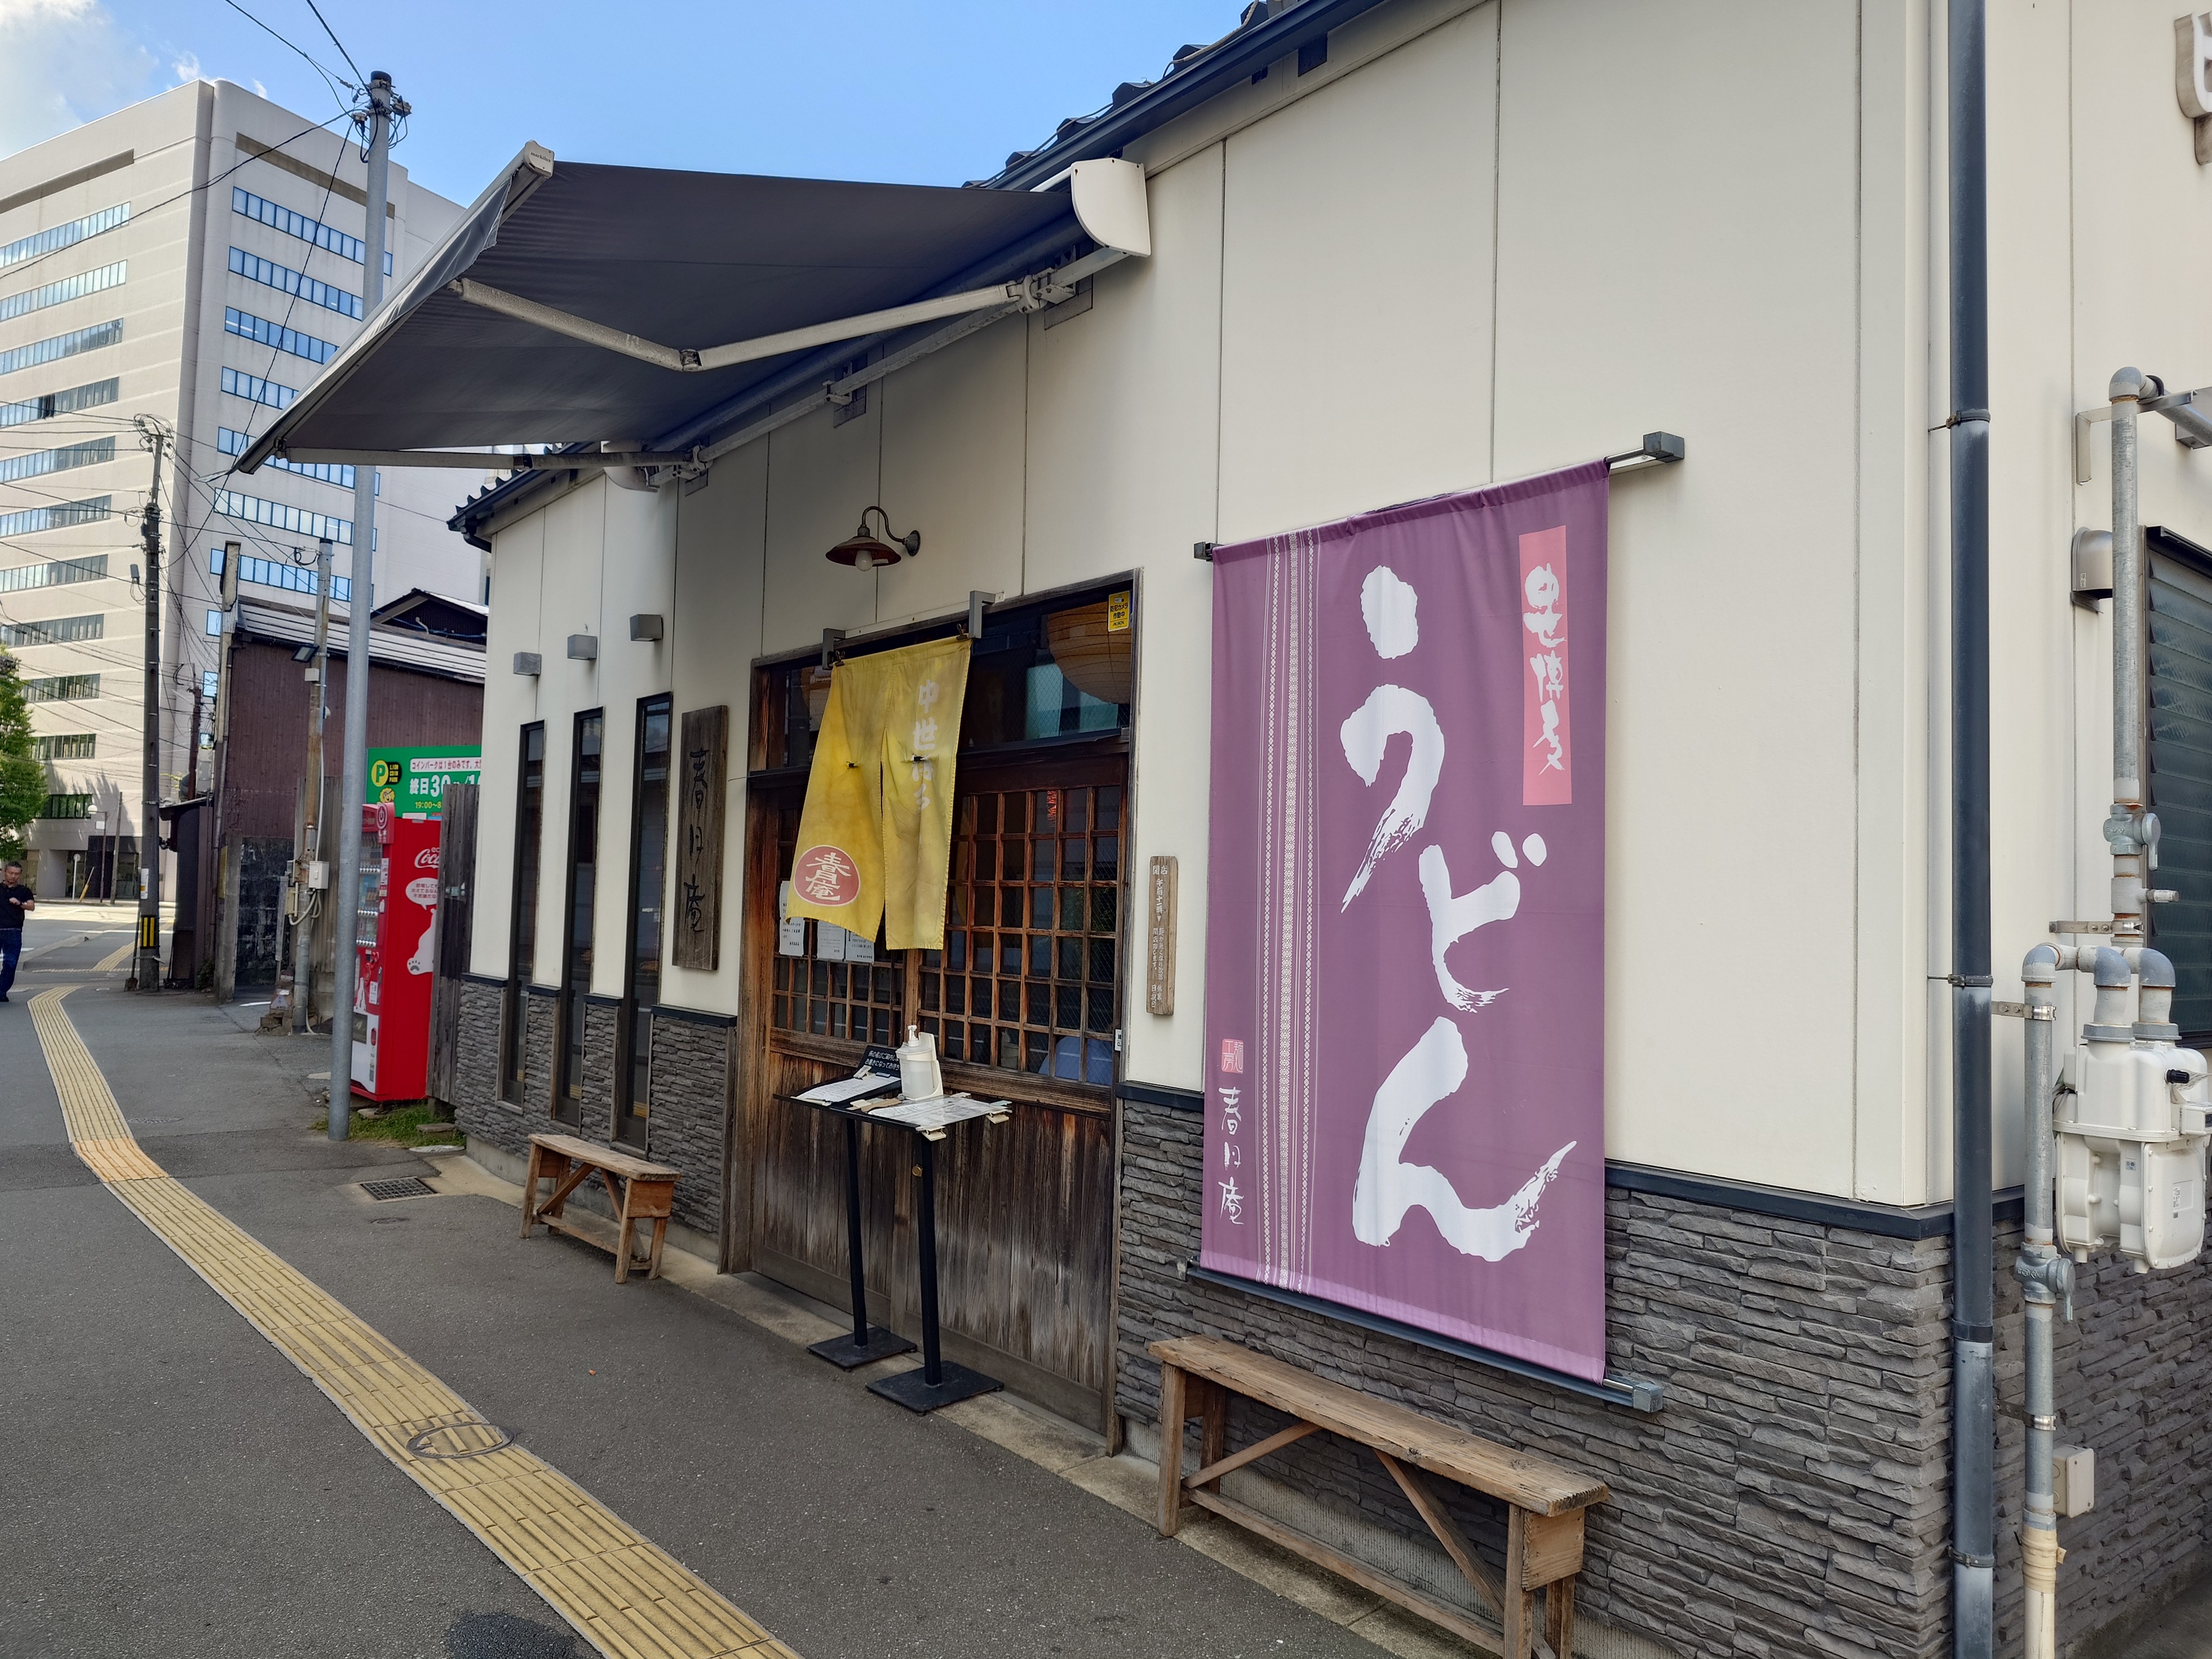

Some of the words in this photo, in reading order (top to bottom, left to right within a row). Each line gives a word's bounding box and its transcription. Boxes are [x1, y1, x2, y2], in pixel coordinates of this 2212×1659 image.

[684, 747, 708, 932] 春日庵
[805, 852, 851, 901] 春日庵
[1152, 865, 1167, 875] 開店
[1340, 565, 1577, 1262] うどん
[1218, 1086, 1244, 1225] 春日庵
